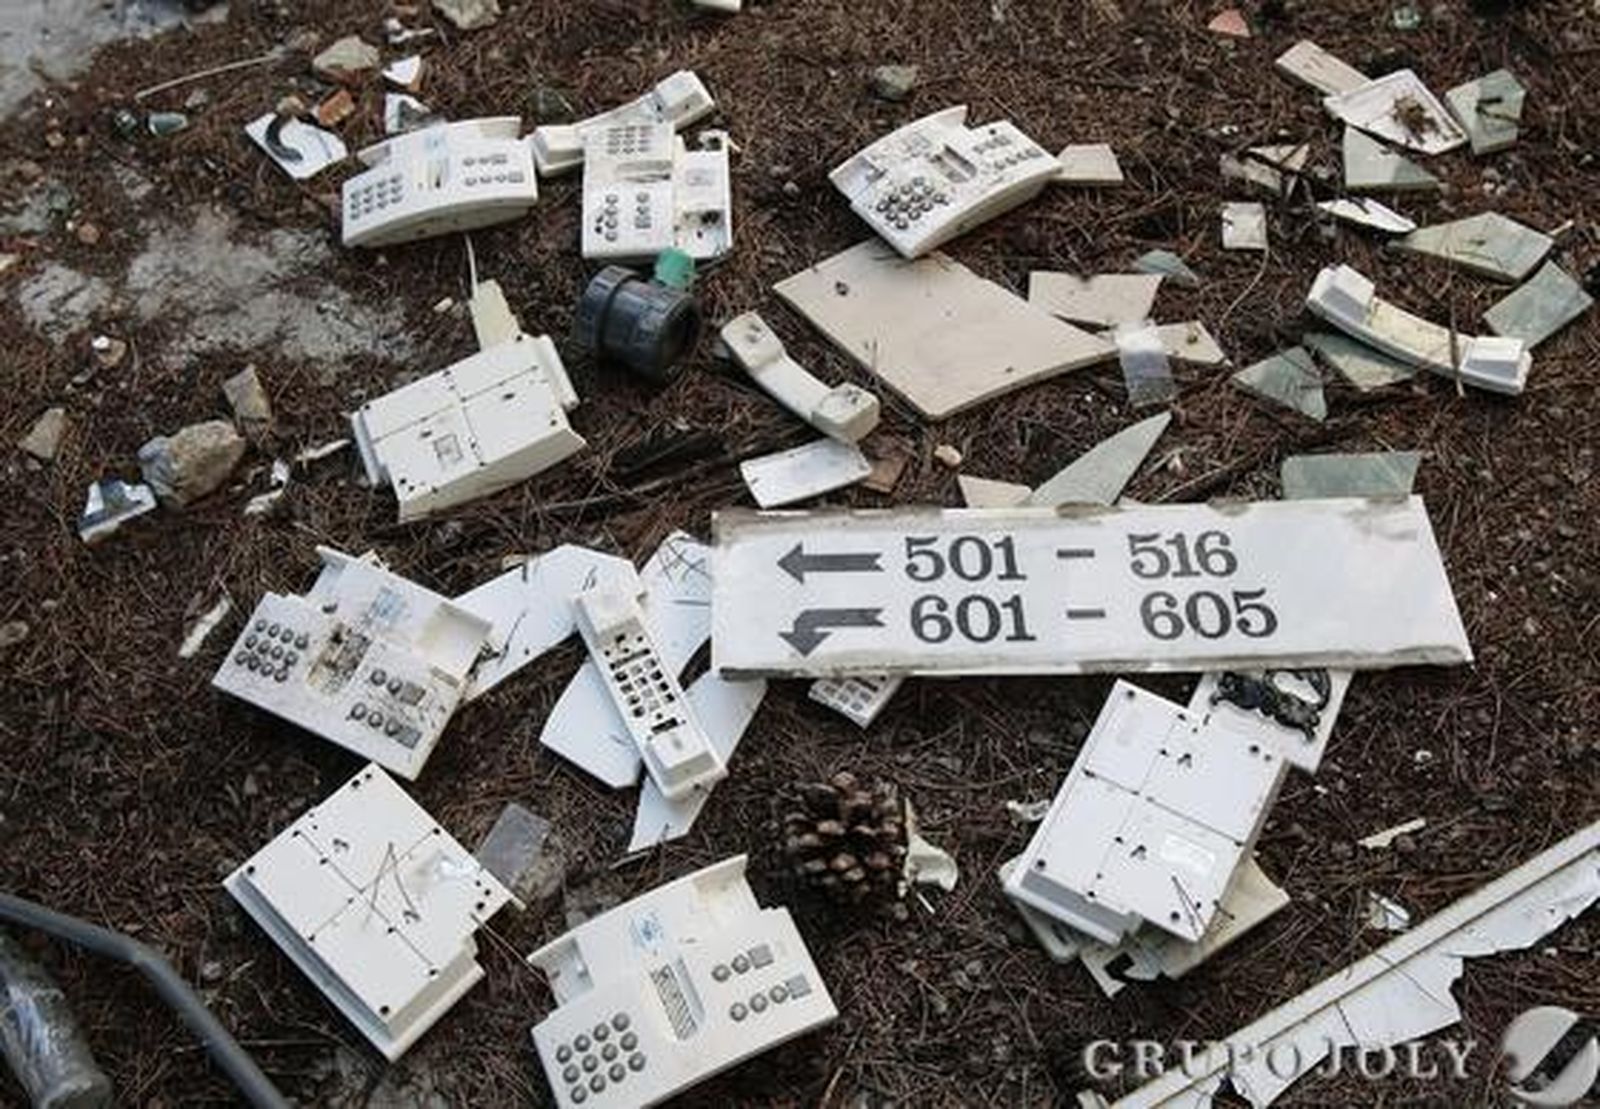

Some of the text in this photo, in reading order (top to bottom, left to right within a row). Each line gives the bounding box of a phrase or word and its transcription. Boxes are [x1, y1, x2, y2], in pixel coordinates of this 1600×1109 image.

[904, 535, 1027, 583] 501
[1127, 531, 1238, 579] 516
[909, 593, 1038, 644] 601
[1140, 588, 1279, 641] 605
